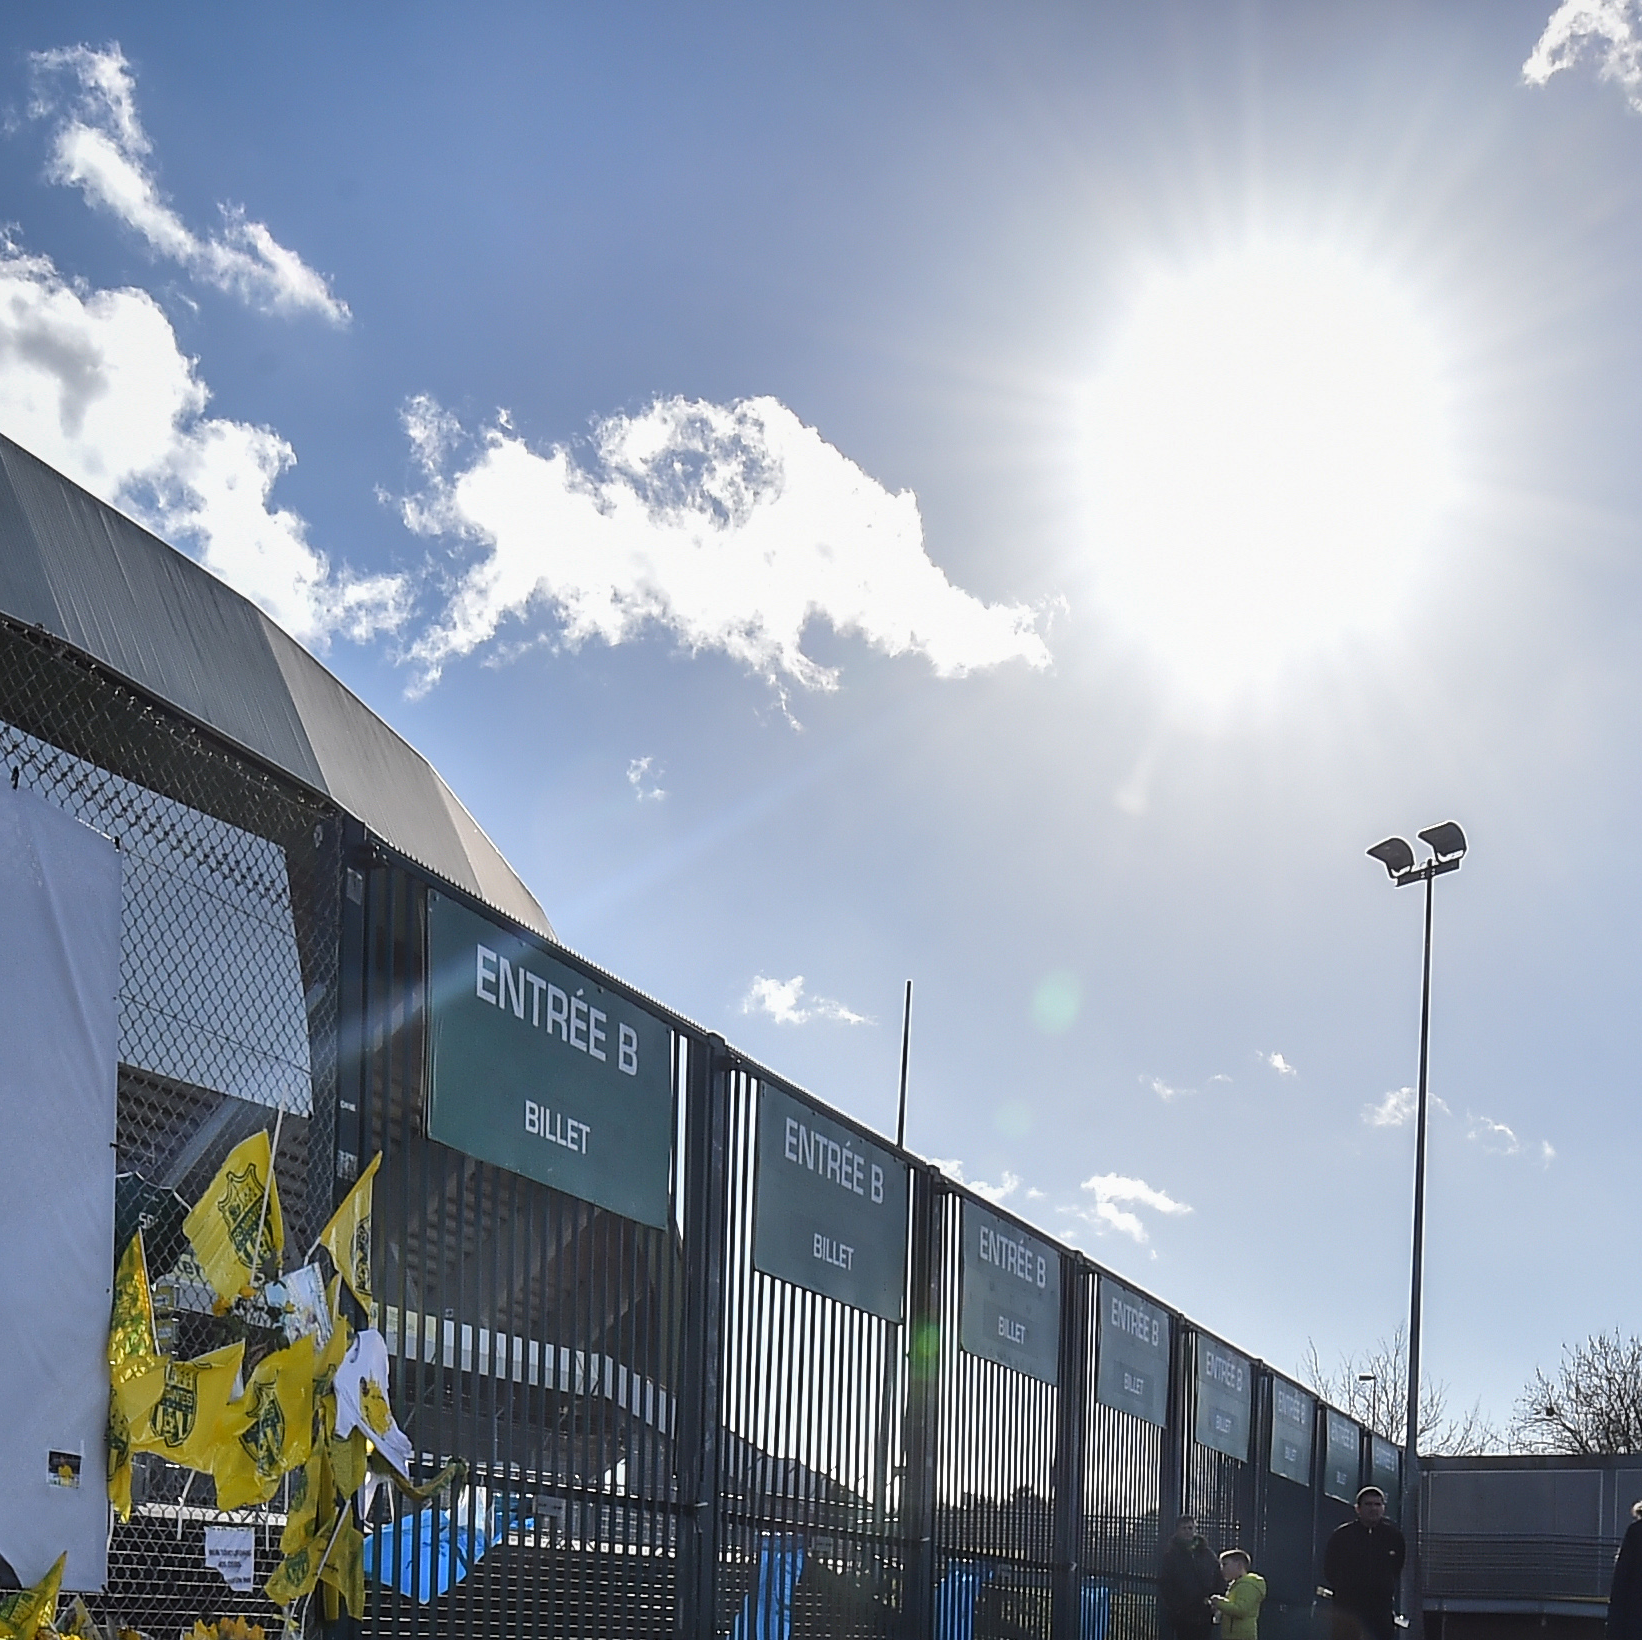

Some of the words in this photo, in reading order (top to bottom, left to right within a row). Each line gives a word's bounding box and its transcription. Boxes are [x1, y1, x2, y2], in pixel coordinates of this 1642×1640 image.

[476, 944, 608, 1061] ENTRÉE
[617, 1023, 639, 1076] B
[524, 1101, 591, 1155] BILLET
[785, 1117, 865, 1196] ENTRÉE
[870, 1163, 885, 1205] B
[812, 1233, 854, 1271] BILLET
[979, 1225, 1033, 1281] ENTRÉE
[1036, 1261, 1046, 1290] B
[998, 1315, 1026, 1344] BILLET
[1111, 1297, 1150, 1341] ENTRÉE
[1151, 1326, 1159, 1347] B
[1123, 1372, 1144, 1395] BILLET
[1206, 1351, 1236, 1388] ENTRÉE
